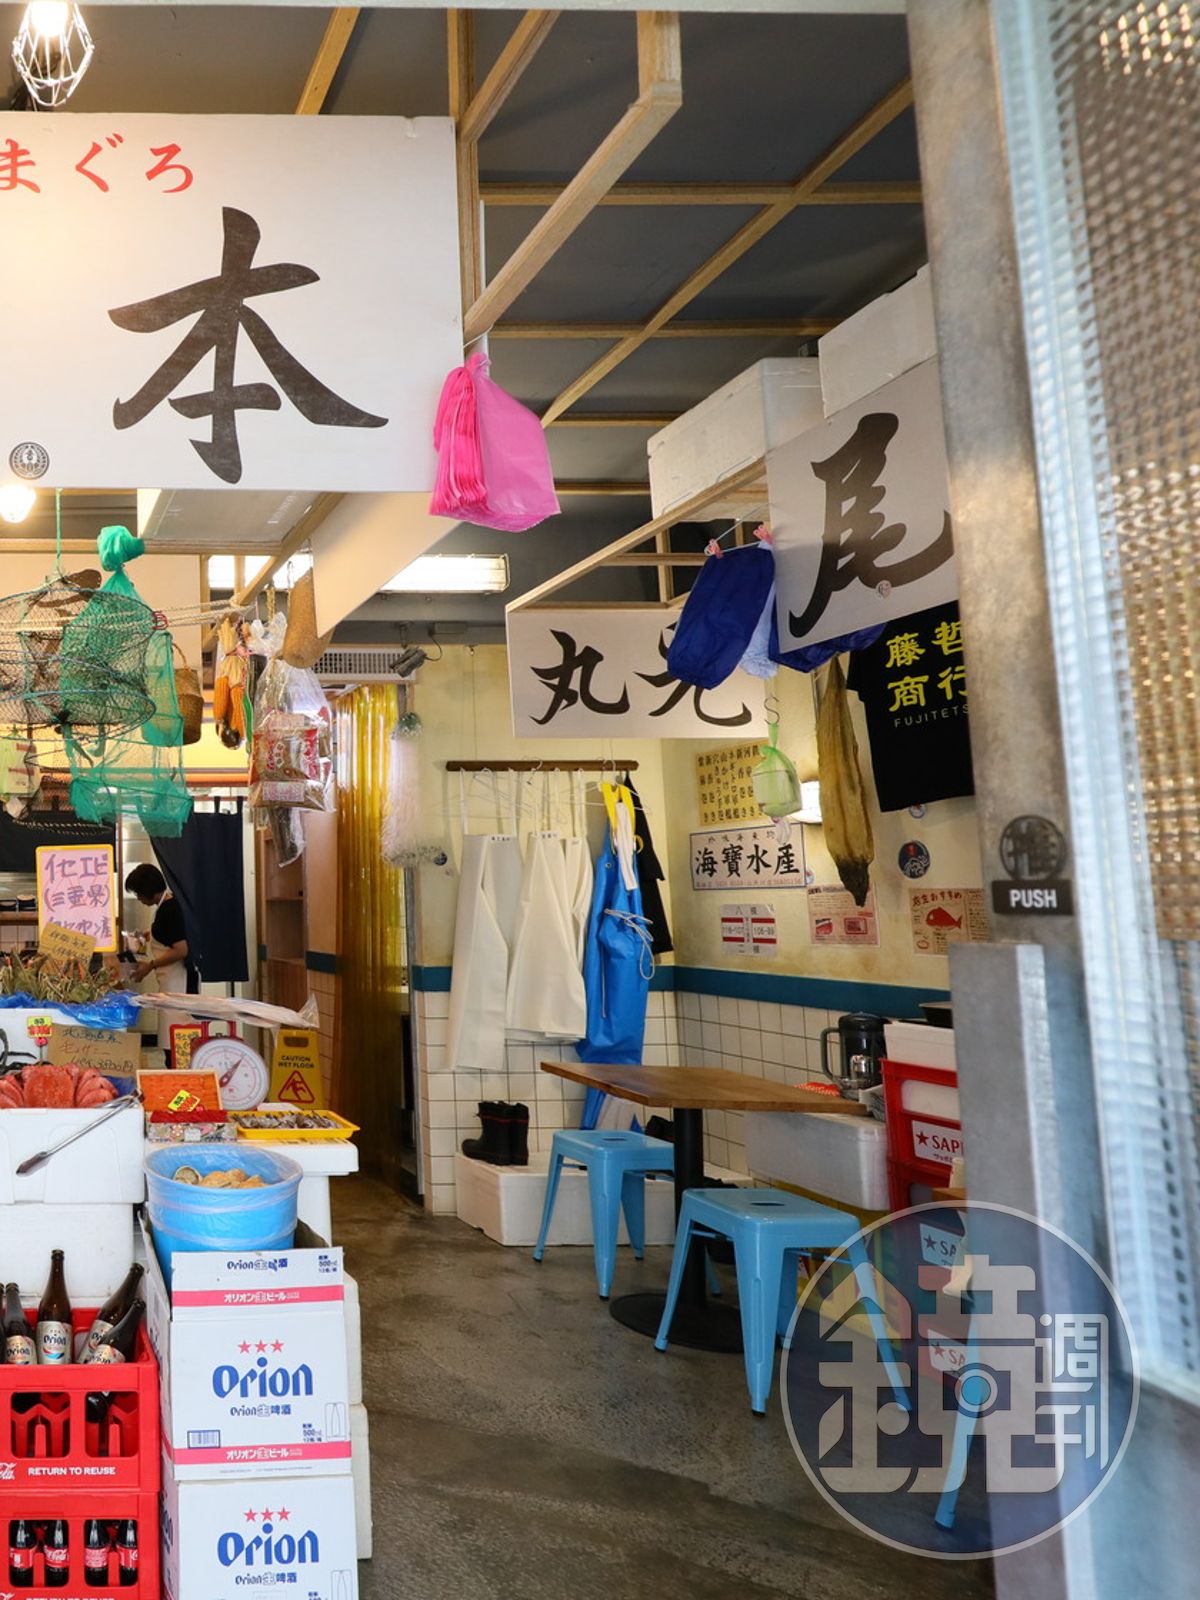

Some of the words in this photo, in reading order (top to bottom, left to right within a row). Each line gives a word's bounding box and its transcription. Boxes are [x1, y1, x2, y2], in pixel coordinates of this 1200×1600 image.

[788, 412, 955, 638] 尾
[1009, 888, 1057, 908] PUSH
[931, 1135, 965, 1156] SAP
[43, 1333, 67, 1345] Orion
[212, 1356, 314, 1398] Orion
[28, 1466, 68, 1476] RETURN
[70, 1466, 82, 1475] TO
[83, 1466, 117, 1476] REUSE
[217, 1523, 320, 1567] Orion
